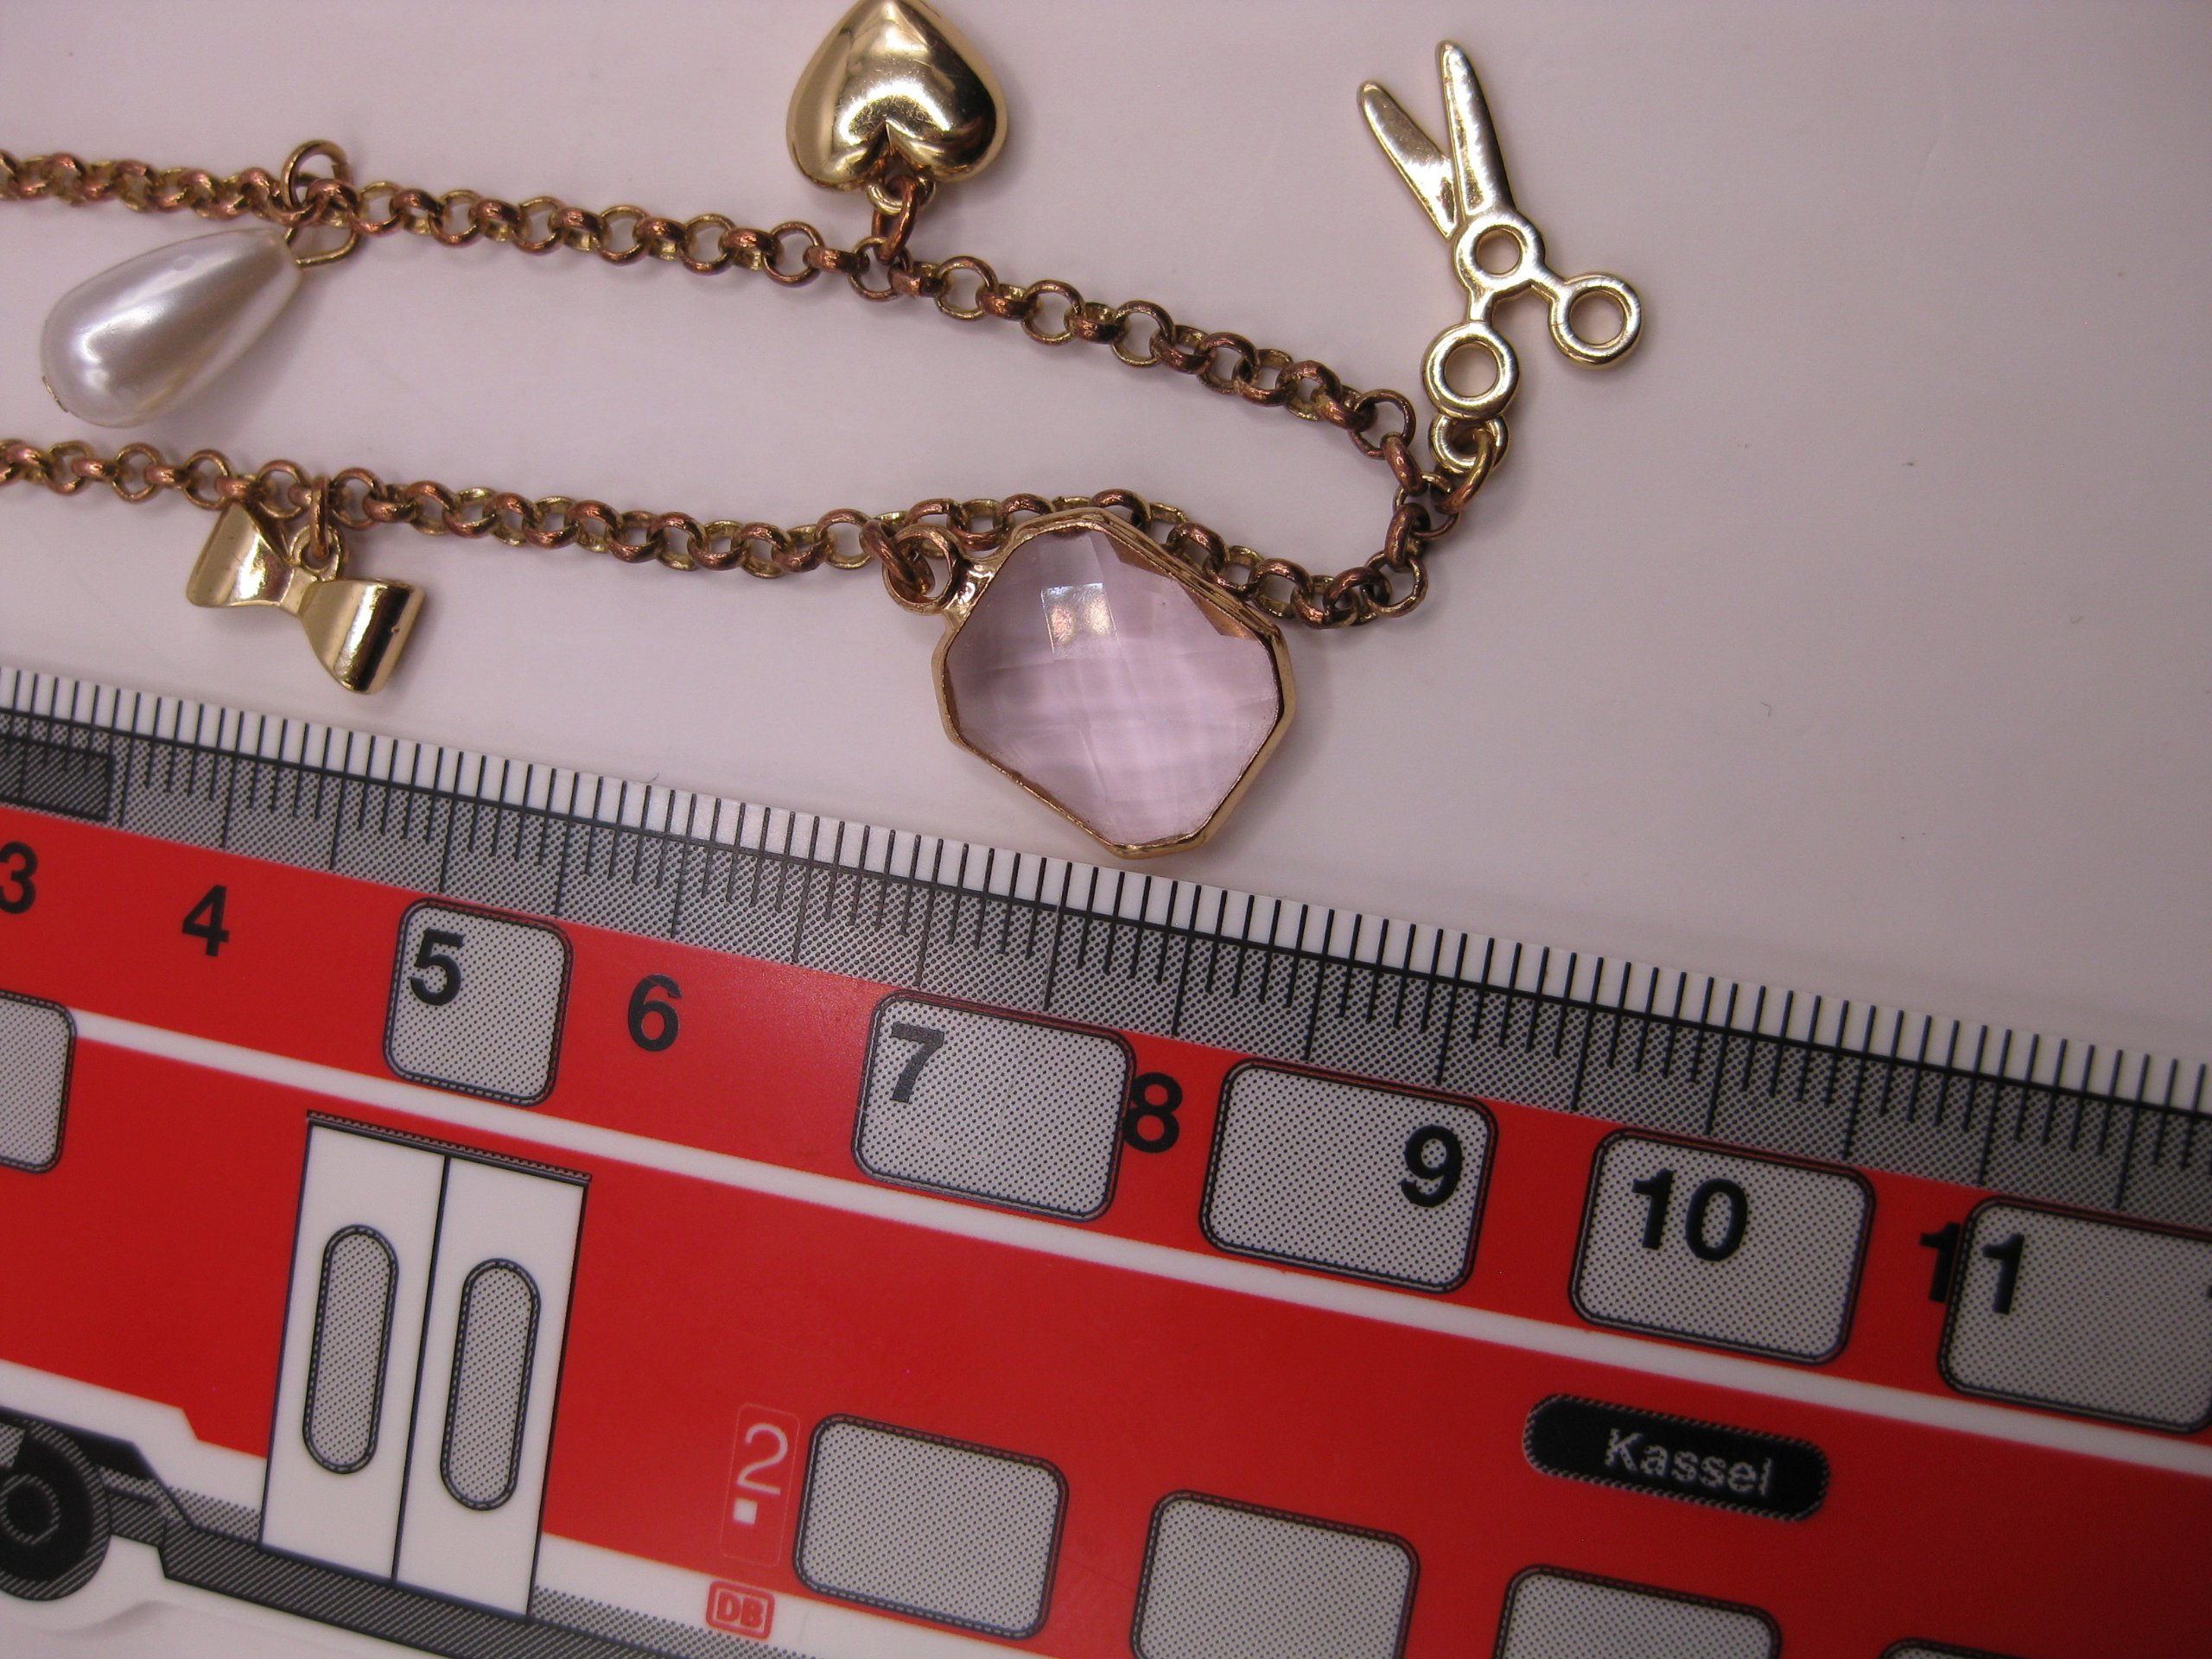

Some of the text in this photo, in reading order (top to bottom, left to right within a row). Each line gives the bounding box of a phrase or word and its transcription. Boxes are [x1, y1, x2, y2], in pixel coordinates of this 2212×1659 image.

[0, 842, 2026, 1315] 3 4 5 6 7 8 9 10 11
[1603, 1427, 1774, 1499] Kassel
[713, 1588, 766, 1631] DB
